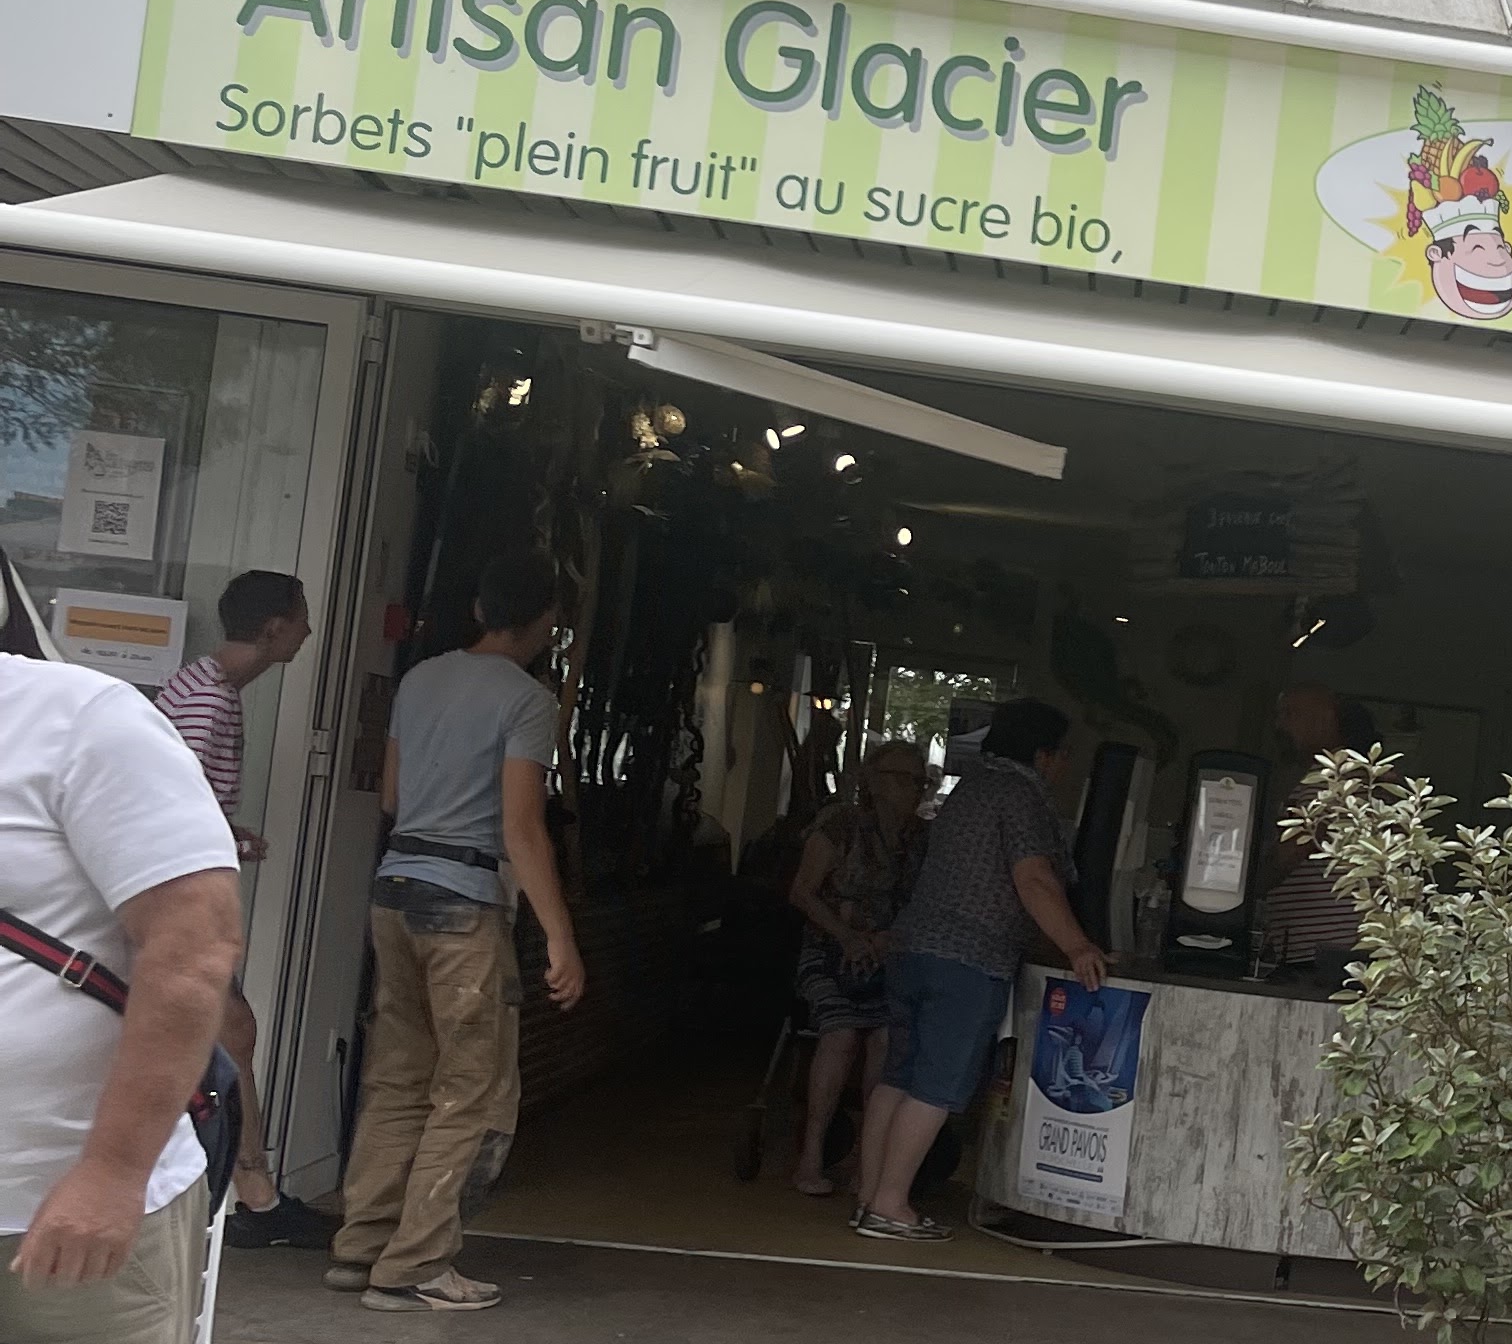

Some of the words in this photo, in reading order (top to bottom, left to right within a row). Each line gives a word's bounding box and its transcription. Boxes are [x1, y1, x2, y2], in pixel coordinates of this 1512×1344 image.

[724, 0, 1148, 159] Glacier
[216, 83, 433, 159] Sorbets
[455, 115, 609, 187] "plein
[630, 138, 757, 202] fruit"
[776, 174, 845, 216] au
[863, 186, 1011, 240] sucre
[1031, 203, 1124, 264] bio,
